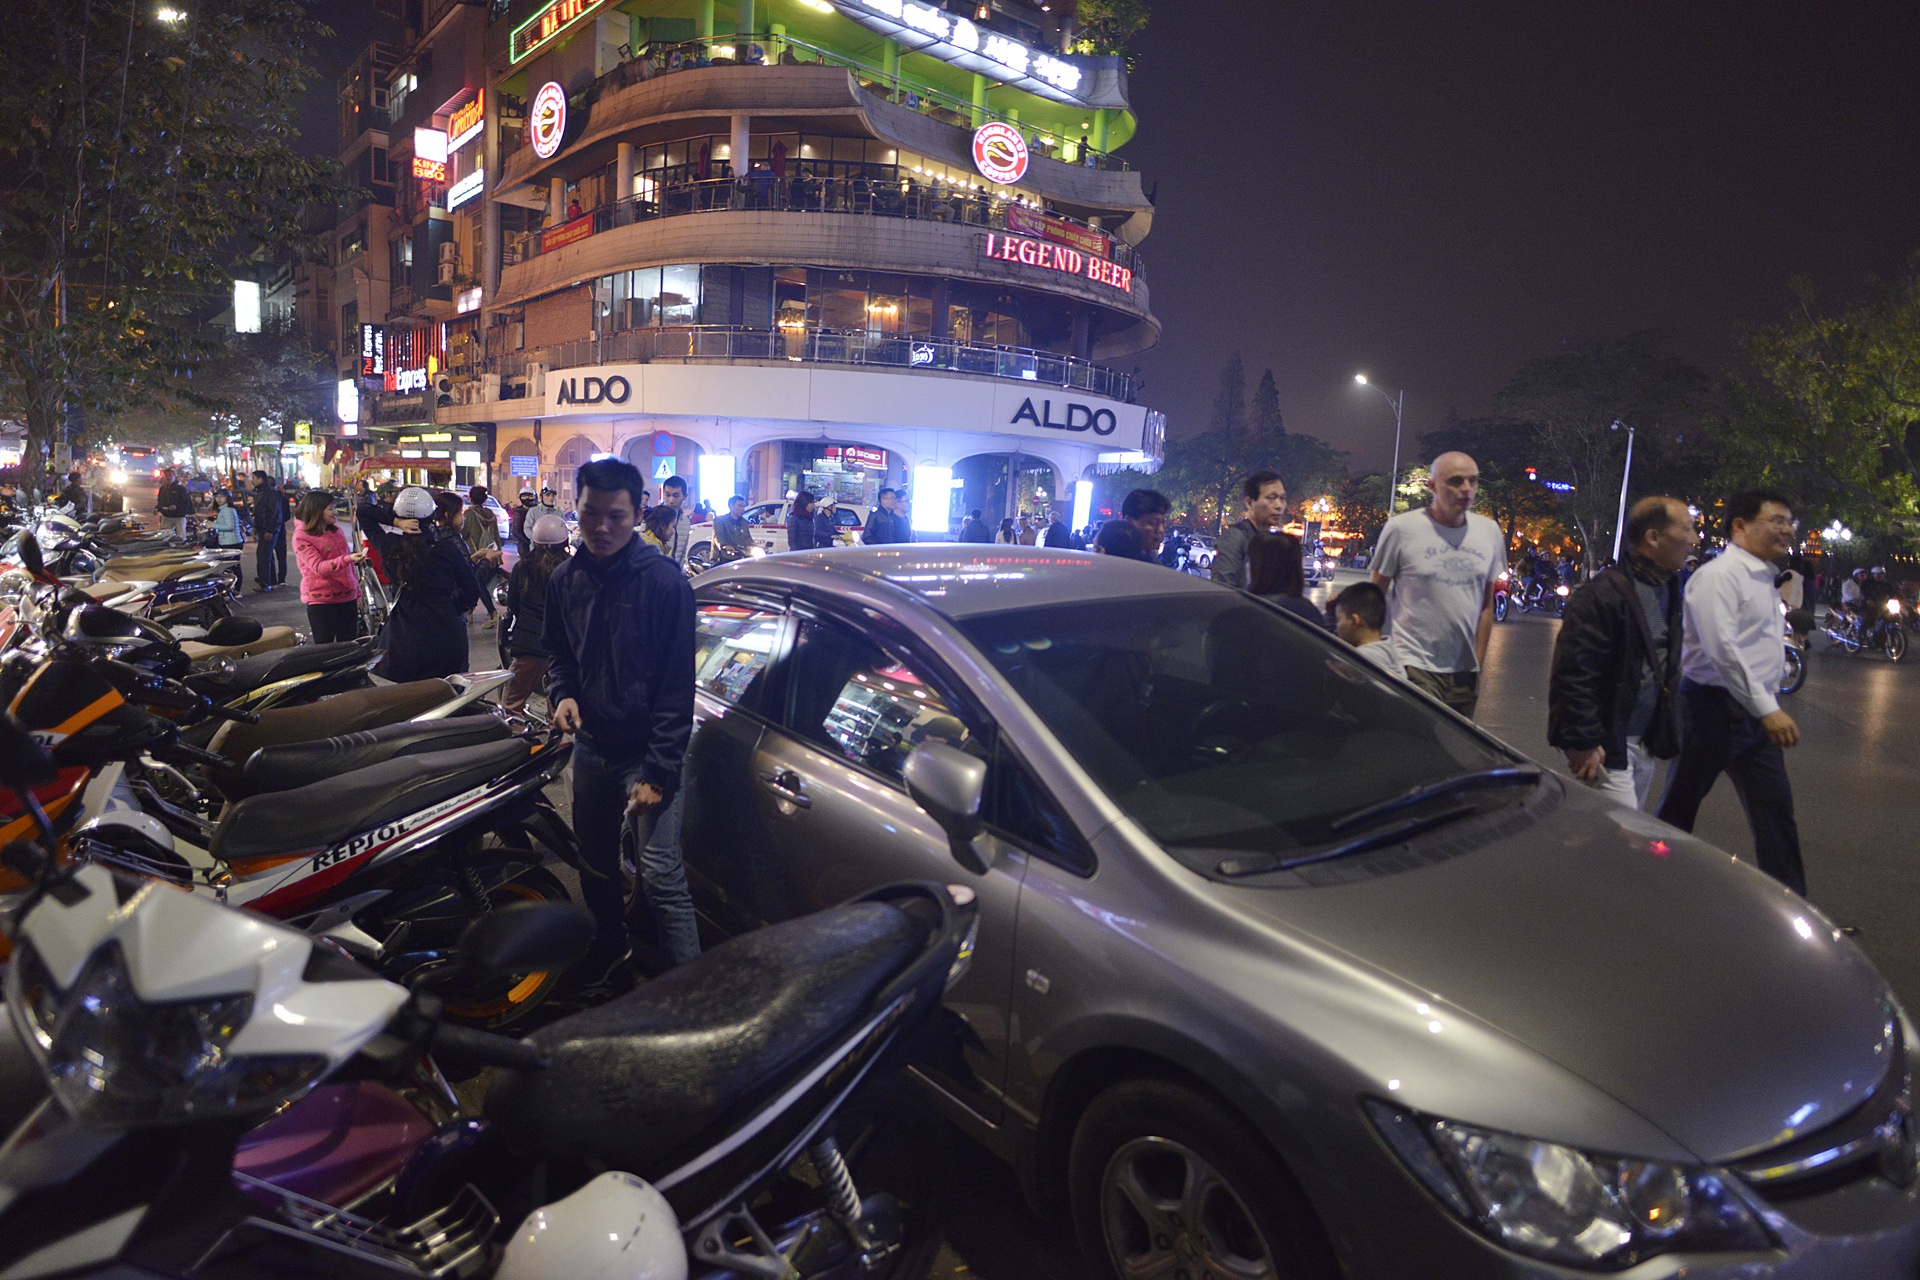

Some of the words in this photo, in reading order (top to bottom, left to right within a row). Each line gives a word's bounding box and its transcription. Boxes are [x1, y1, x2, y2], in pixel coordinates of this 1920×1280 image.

[977, 125, 1026, 159] HIGHLANDS
[413, 157, 445, 172] KING
[413, 168, 445, 182] BBQ
[979, 159, 1018, 181] COFFEE
[986, 233, 1082, 274] LEGEND
[1087, 256, 1132, 293] BEER
[556, 375, 630, 404] ALDO
[1011, 397, 1116, 435] ALDO
[312, 820, 410, 872] REPSOL
